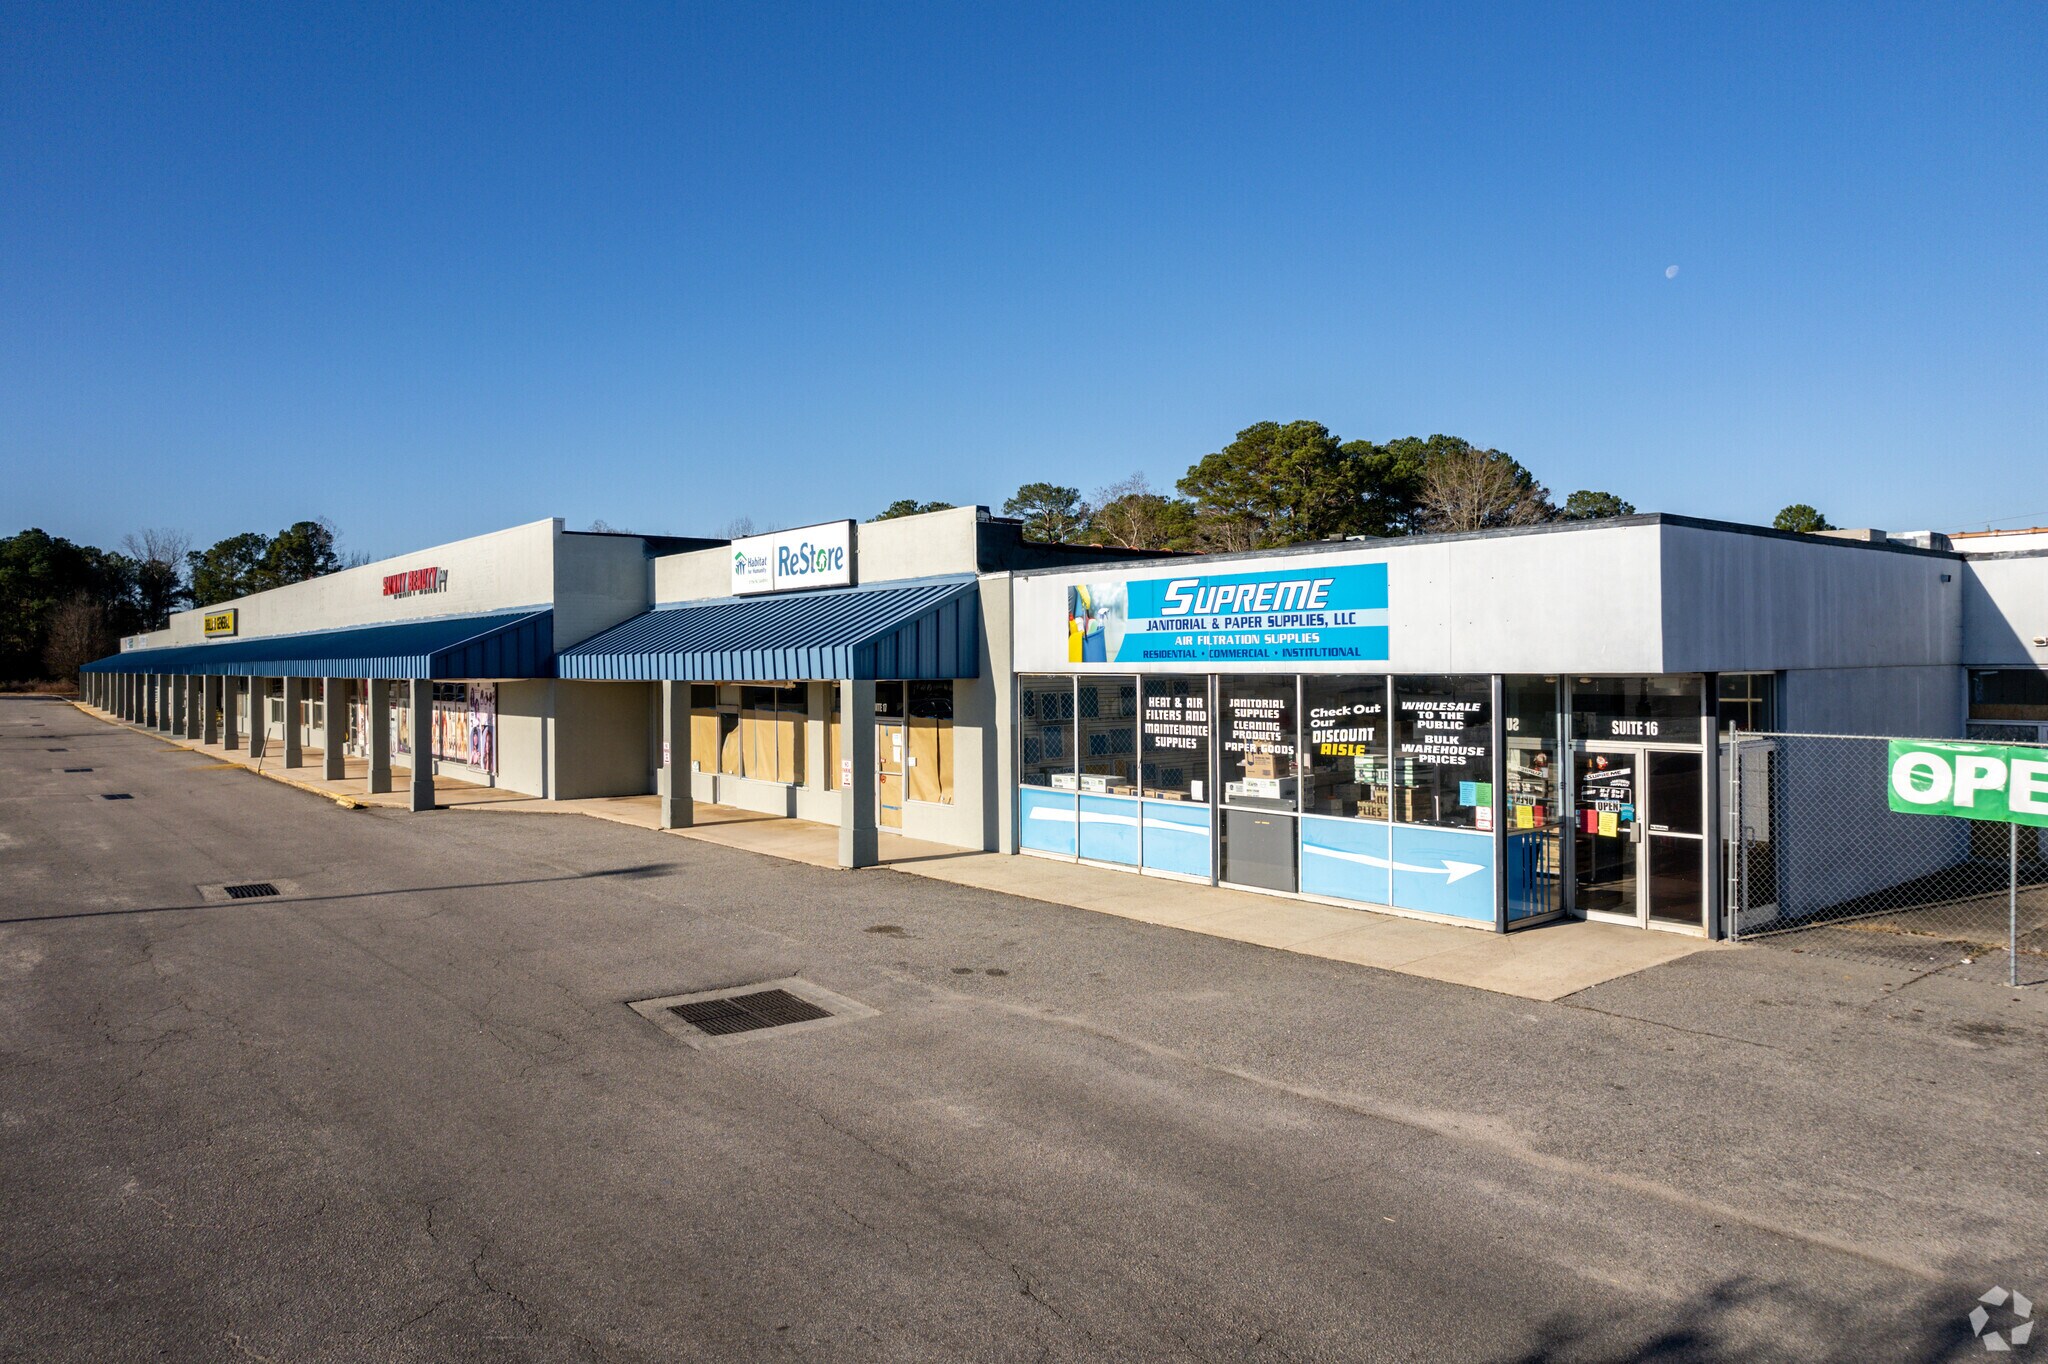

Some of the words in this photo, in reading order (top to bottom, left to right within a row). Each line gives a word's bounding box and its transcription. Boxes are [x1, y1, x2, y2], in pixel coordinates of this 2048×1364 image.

[747, 556, 768, 568] Habitat
[778, 542, 844, 577] ReStore
[383, 572, 407, 596] SUNNY
[408, 567, 439, 591] BEAUTY
[1161, 578, 1335, 616] SUPREME
[1146, 618, 1208, 632] JANITORIAL
[1212, 617, 1220, 630] &
[1225, 616, 1263, 629] PAPER
[1267, 613, 1329, 628] SUPPLIES,
[1333, 612, 1357, 625] LLC
[1175, 636, 1194, 646] AIR
[1197, 634, 1260, 646] FILTRATION
[1264, 632, 1320, 644] SUPPLIES
[1143, 649, 1197, 659] RESIDENTIAL
[1208, 648, 1270, 659] COMMERCIAL
[1282, 646, 1361, 658] INSTITUTIONAL
[1149, 697, 1171, 708] HEAT
[1174, 697, 1182, 708] &
[1186, 697, 1203, 708] AIR
[1229, 699, 1285, 709] JANITORIAL
[1402, 701, 1481, 711] WHOLESALE
[1146, 710, 1182, 721] FILTERS
[1185, 710, 1207, 722] AND
[1234, 708, 1280, 719] SUPPLIES
[1310, 706, 1351, 718] Check
[1353, 704, 1381, 714] Out
[1418, 711, 1434, 719] TO
[1439, 711, 1464, 720] THE
[1145, 723, 1208, 736] MAINTENANCE
[1233, 721, 1280, 731] CLEANING
[1311, 719, 1335, 728] Our
[1417, 720, 1464, 730] PUBLIC
[1611, 720, 1642, 735] SUITE
[1645, 722, 1659, 736] 16
[1232, 730, 1281, 742] PRODUCTS
[1312, 728, 1375, 743] DISCOUNT
[1425, 735, 1459, 745] BULK
[1155, 737, 1197, 749] SUPPLIES
[1225, 742, 1256, 753] PAPER
[1261, 744, 1294, 755] GOODS
[1320, 743, 1365, 757] AISLE
[1401, 744, 1485, 756] WAREHOUSE
[1419, 755, 1467, 765] PRICES
[1588, 769, 1622, 779] SUPREME
[1891, 751, 2048, 816] OPE
[1597, 802, 1619, 812] OPEN
